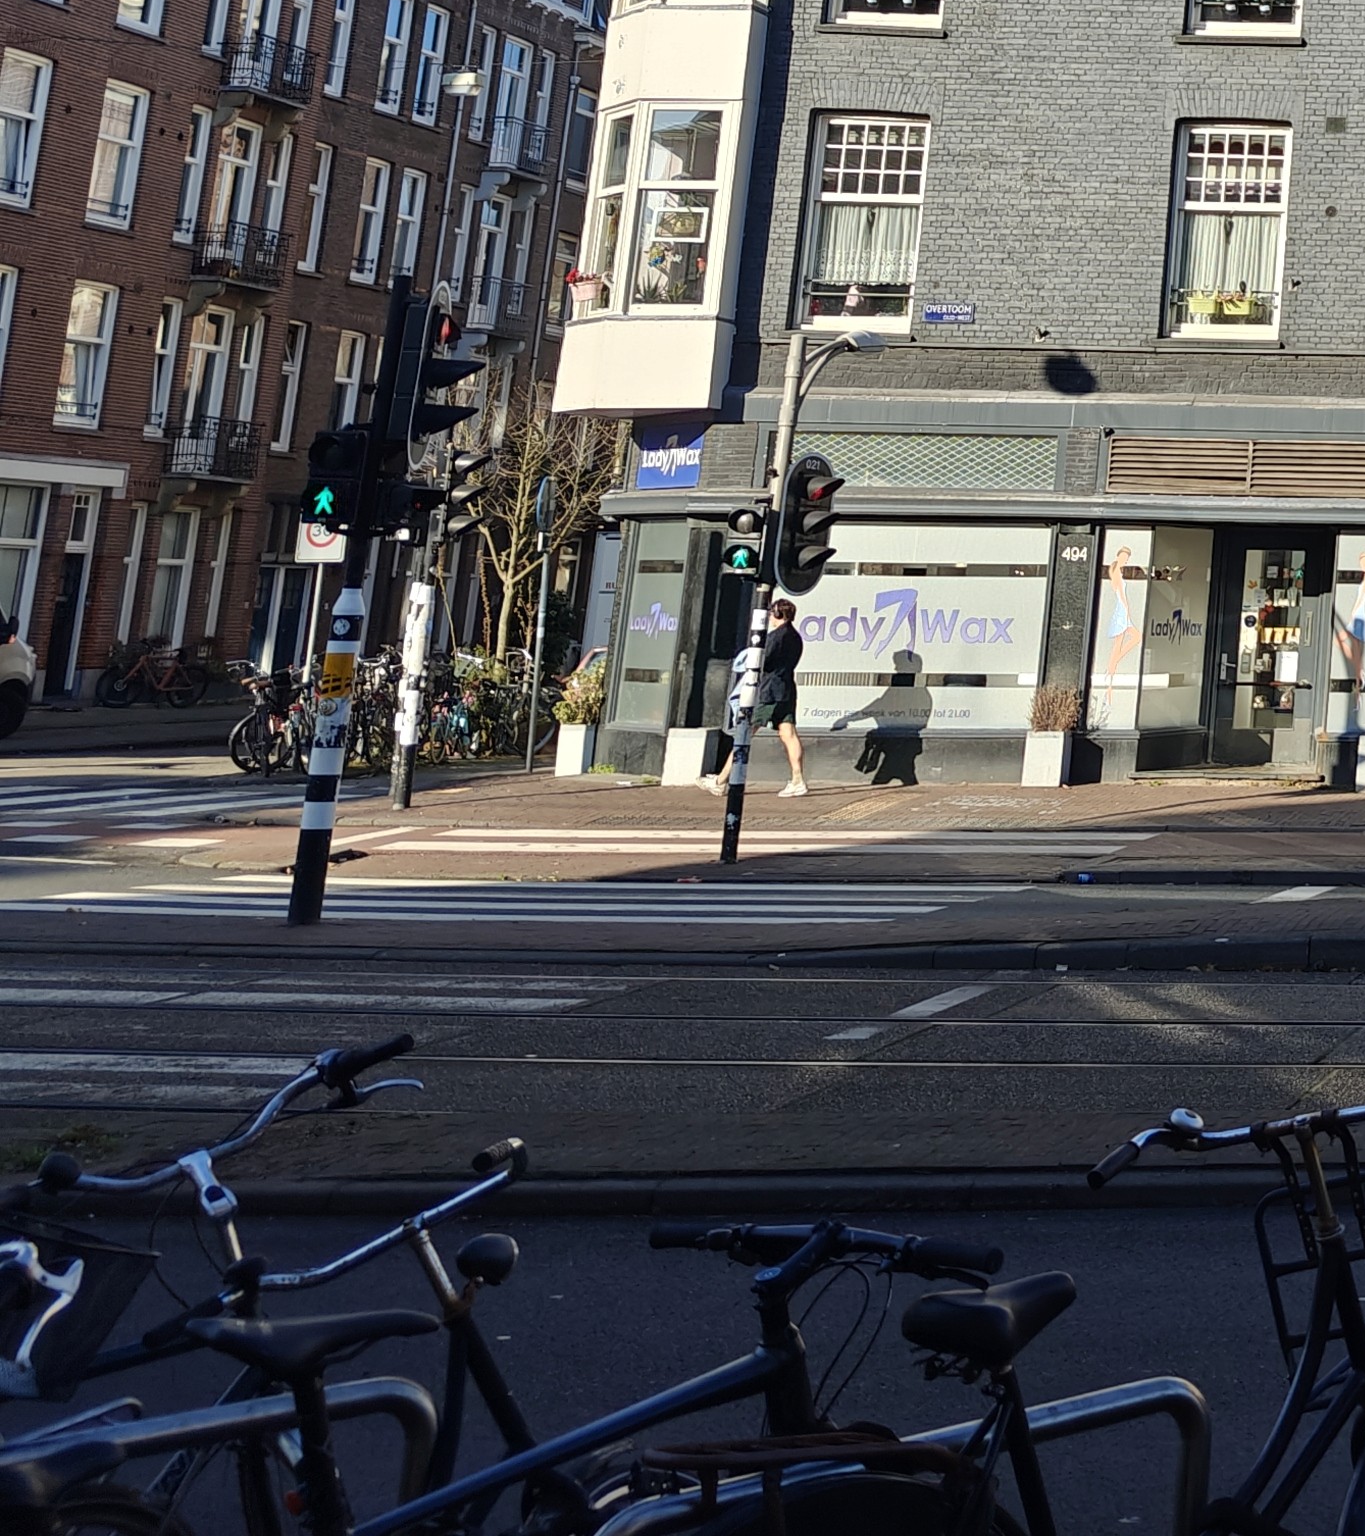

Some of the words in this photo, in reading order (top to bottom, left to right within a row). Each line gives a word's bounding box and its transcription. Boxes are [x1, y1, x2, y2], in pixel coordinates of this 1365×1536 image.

[925, 304, 972, 314] OVERTOOM
[641, 446, 669, 472] Lady
[676, 446, 701, 466] Wax
[806, 459, 821, 470] 021
[1061, 546, 1088, 562] 494
[630, 615, 654, 635] Lady
[799, 607, 886, 651] ady
[920, 608, 1015, 644] Wax
[1151, 618, 1174, 642] Lady
[1182, 619, 1203, 637] Wax
[803, 708, 810, 717] 7
[811, 708, 842, 719] dagen
